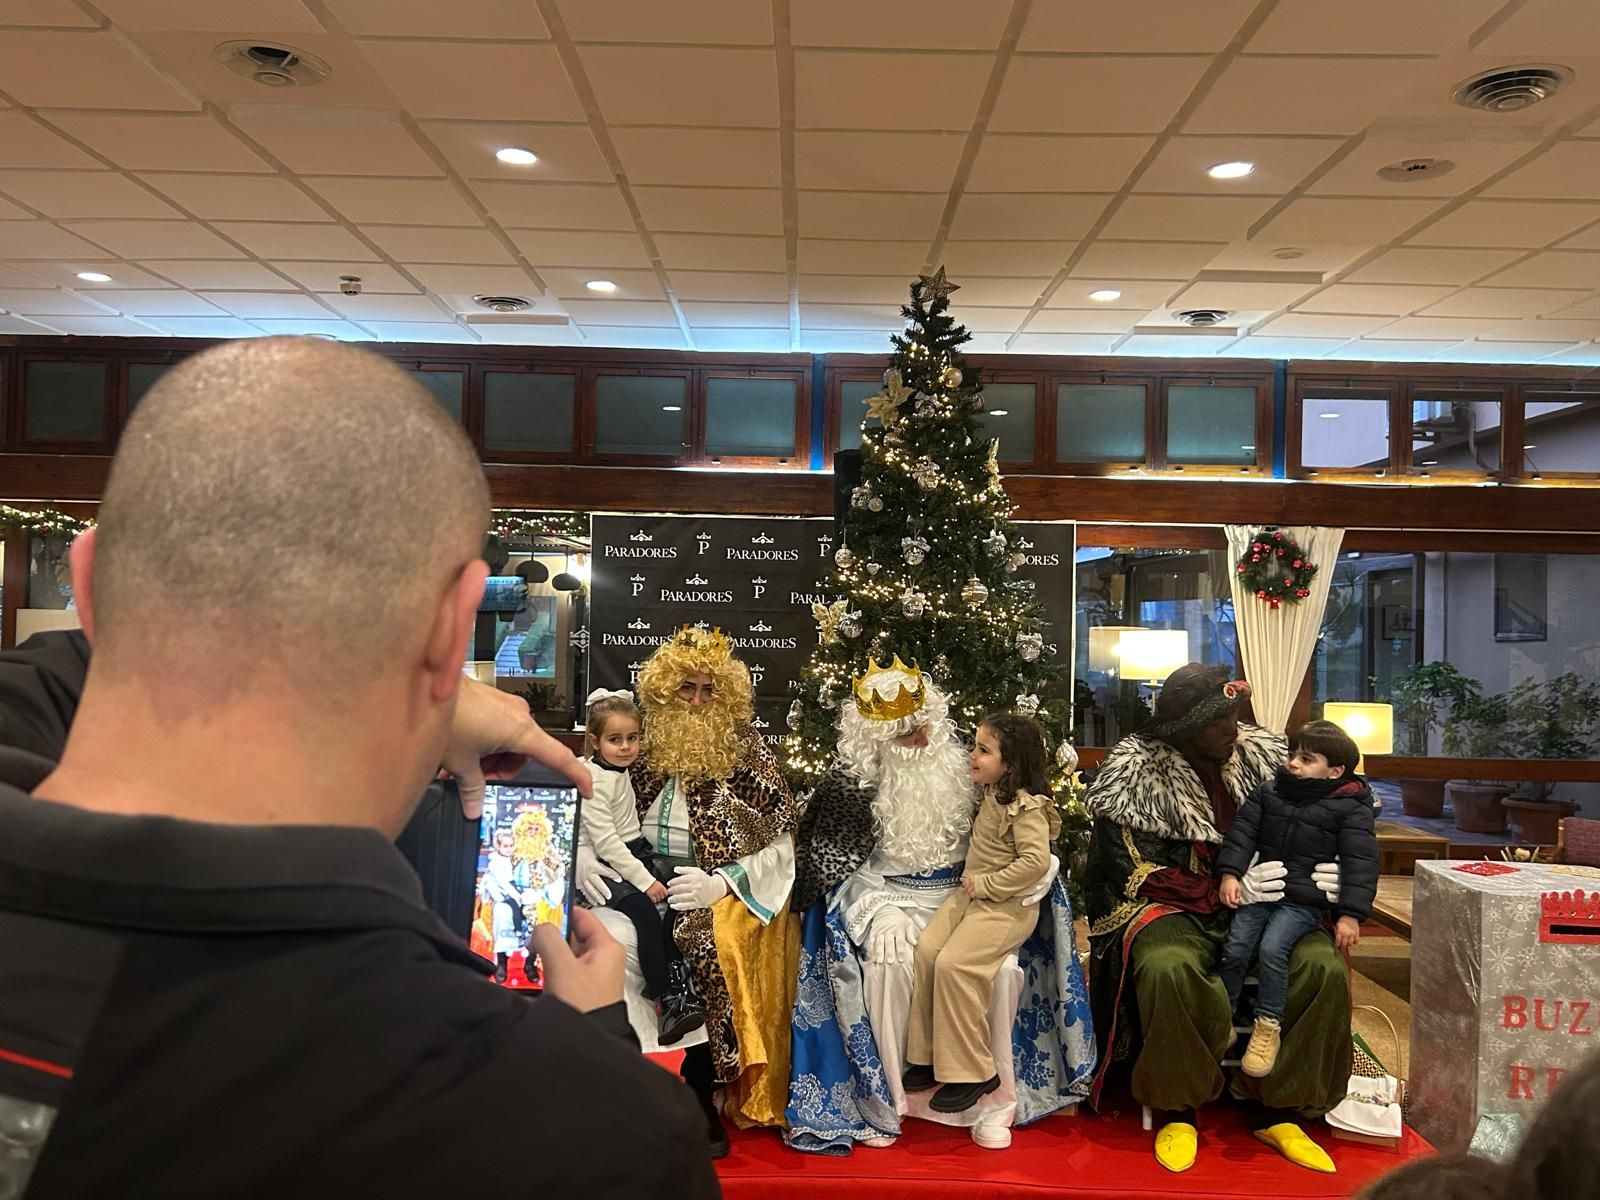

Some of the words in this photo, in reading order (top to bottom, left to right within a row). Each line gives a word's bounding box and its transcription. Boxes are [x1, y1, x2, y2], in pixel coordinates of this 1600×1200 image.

[604, 545, 677, 558] PARADORES
[698, 541, 710, 555] P
[726, 547, 799, 561] PARADORES
[819, 543, 831, 557] P
[632, 583, 644, 596] P
[660, 589, 733, 602] PARADORES
[754, 585, 766, 599] P
[752, 673, 763, 687] P
[1502, 995, 1600, 1035] BUZ
